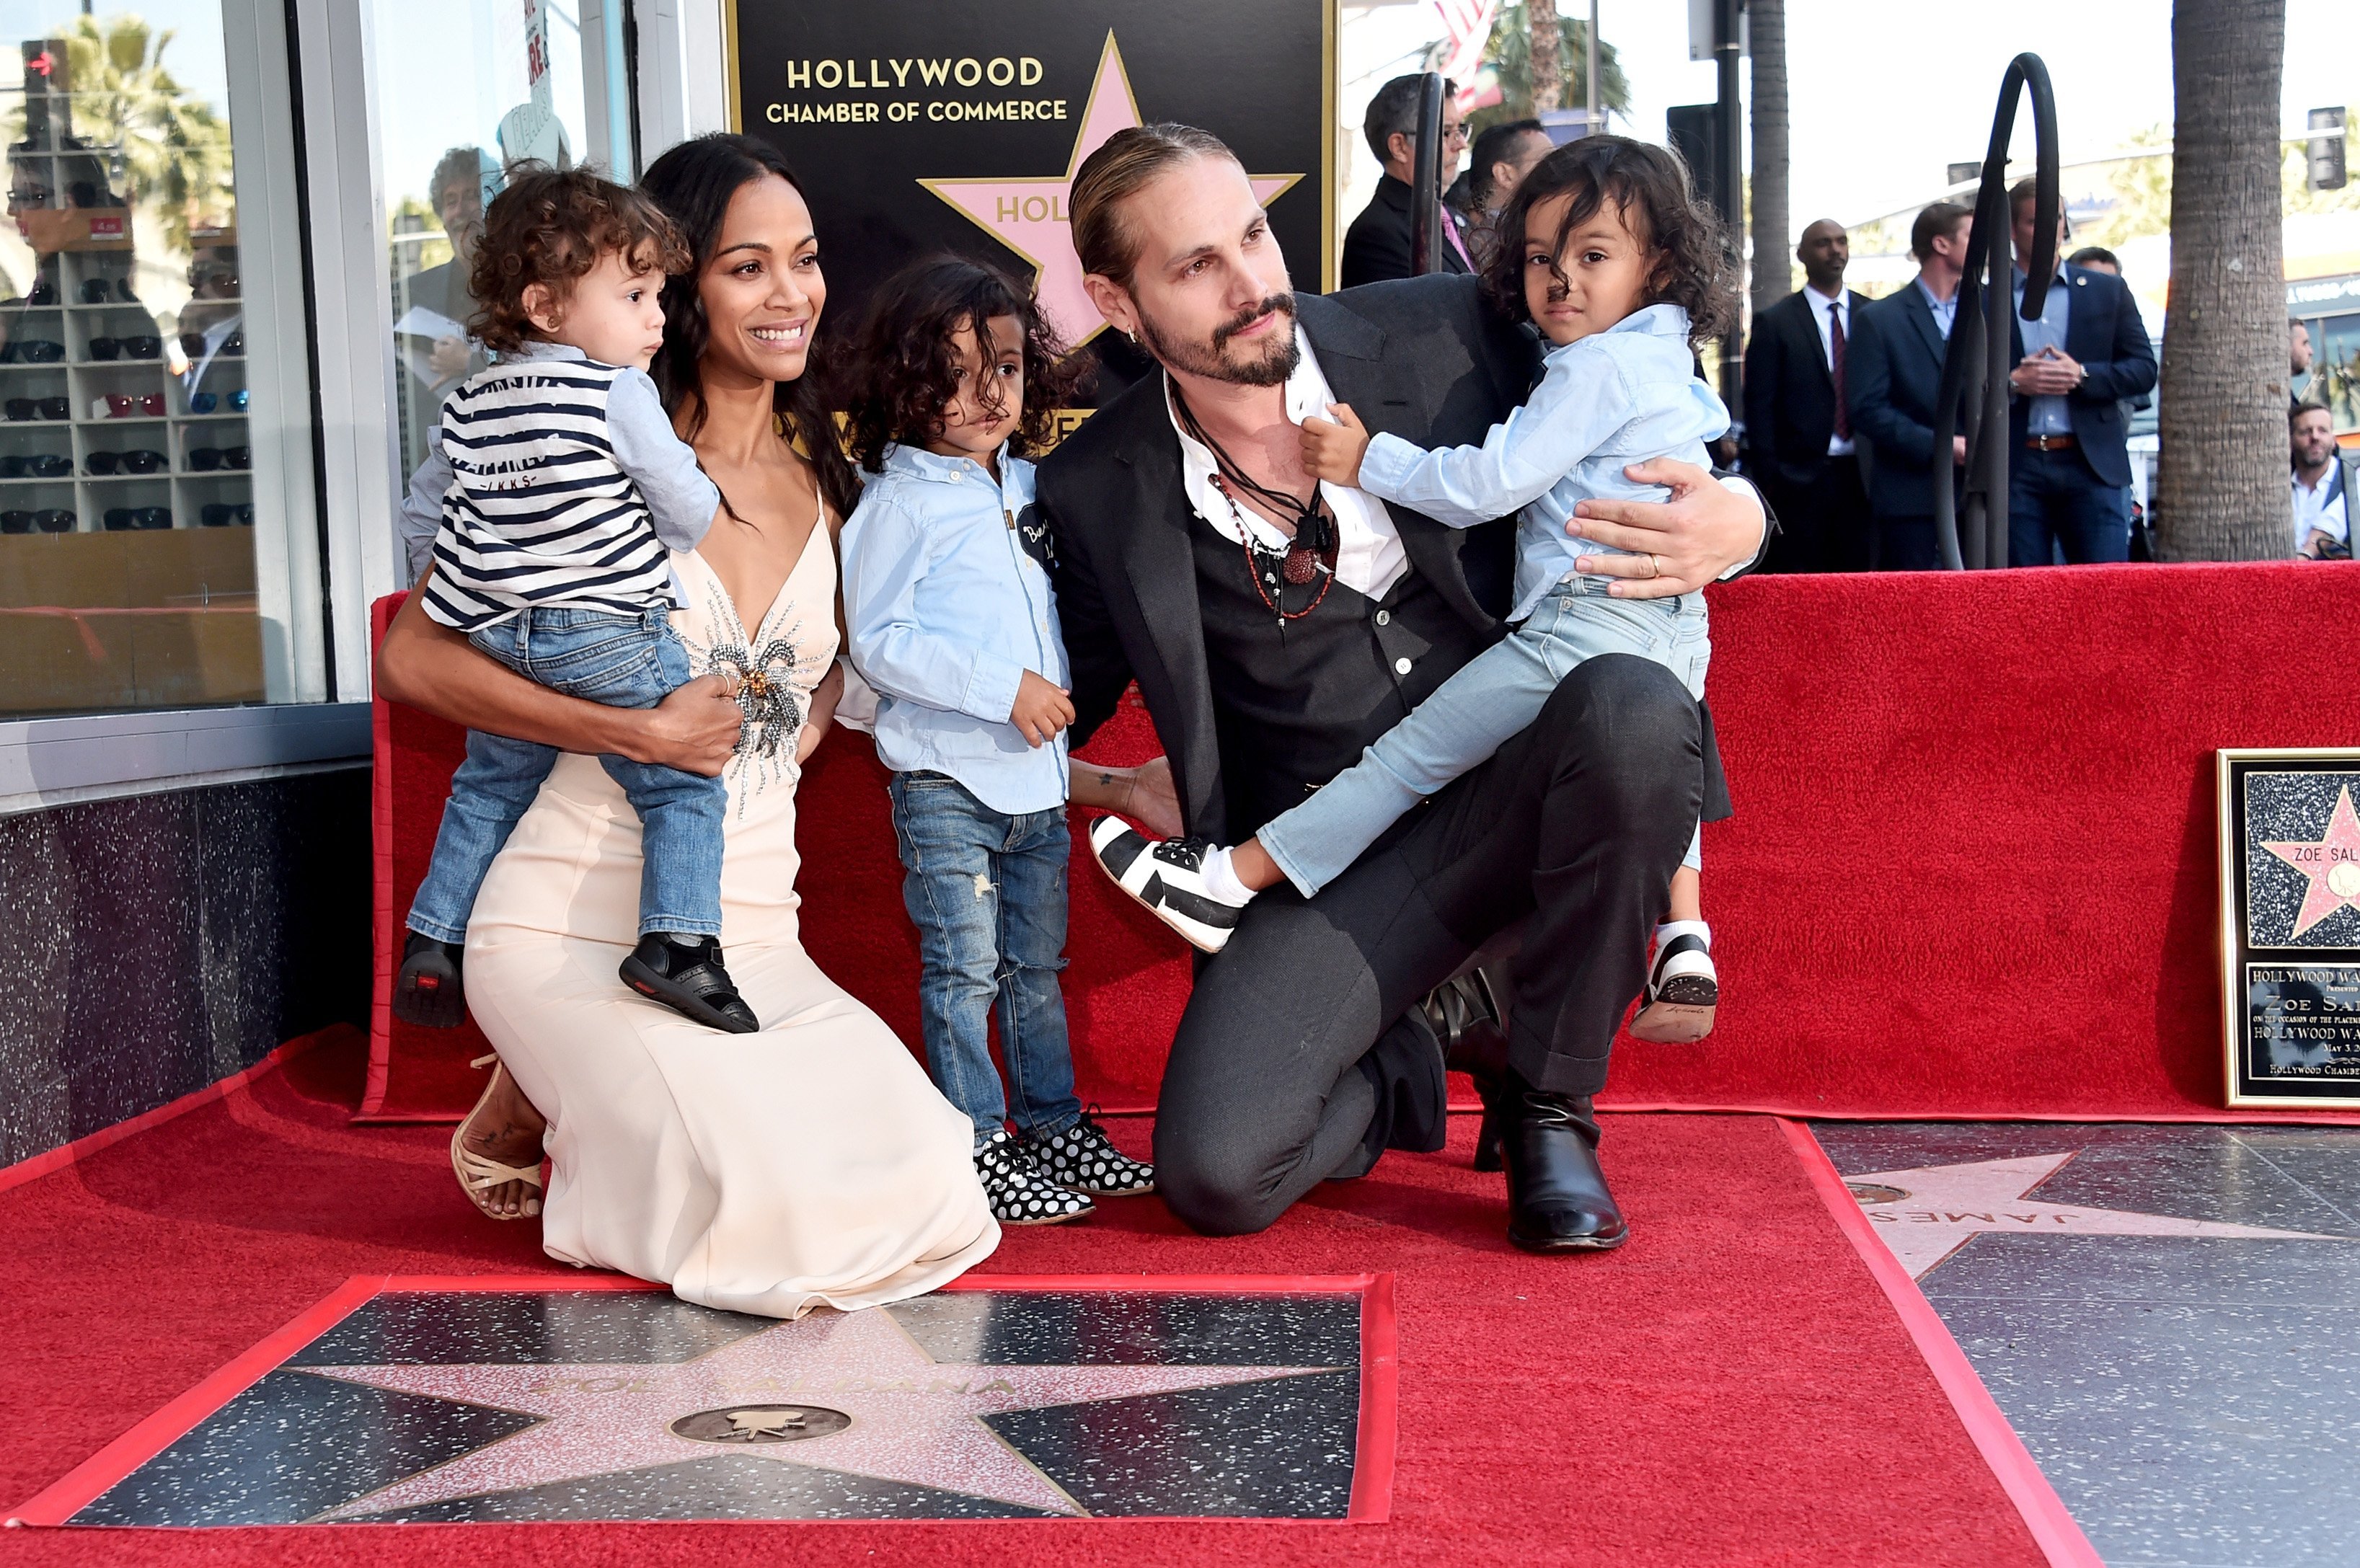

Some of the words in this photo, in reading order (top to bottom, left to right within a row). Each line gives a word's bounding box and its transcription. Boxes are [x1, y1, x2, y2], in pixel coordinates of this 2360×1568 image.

[787, 57, 1044, 89] HOLLYWOOD
[766, 102, 880, 123] CHAMBER
[887, 101, 920, 123] OF
[927, 99, 1067, 122] COMMERCE
[2294, 848, 2322, 861] ZOE
[2330, 847, 2360, 861] SAL
[2253, 970, 2334, 983] HOLLYWOOD
[2254, 1027, 2336, 1040] HOLLYWOOD
[2269, 1065, 2322, 1075] HOLLYWOOD
[1868, 1211, 2080, 1224] JAMES
